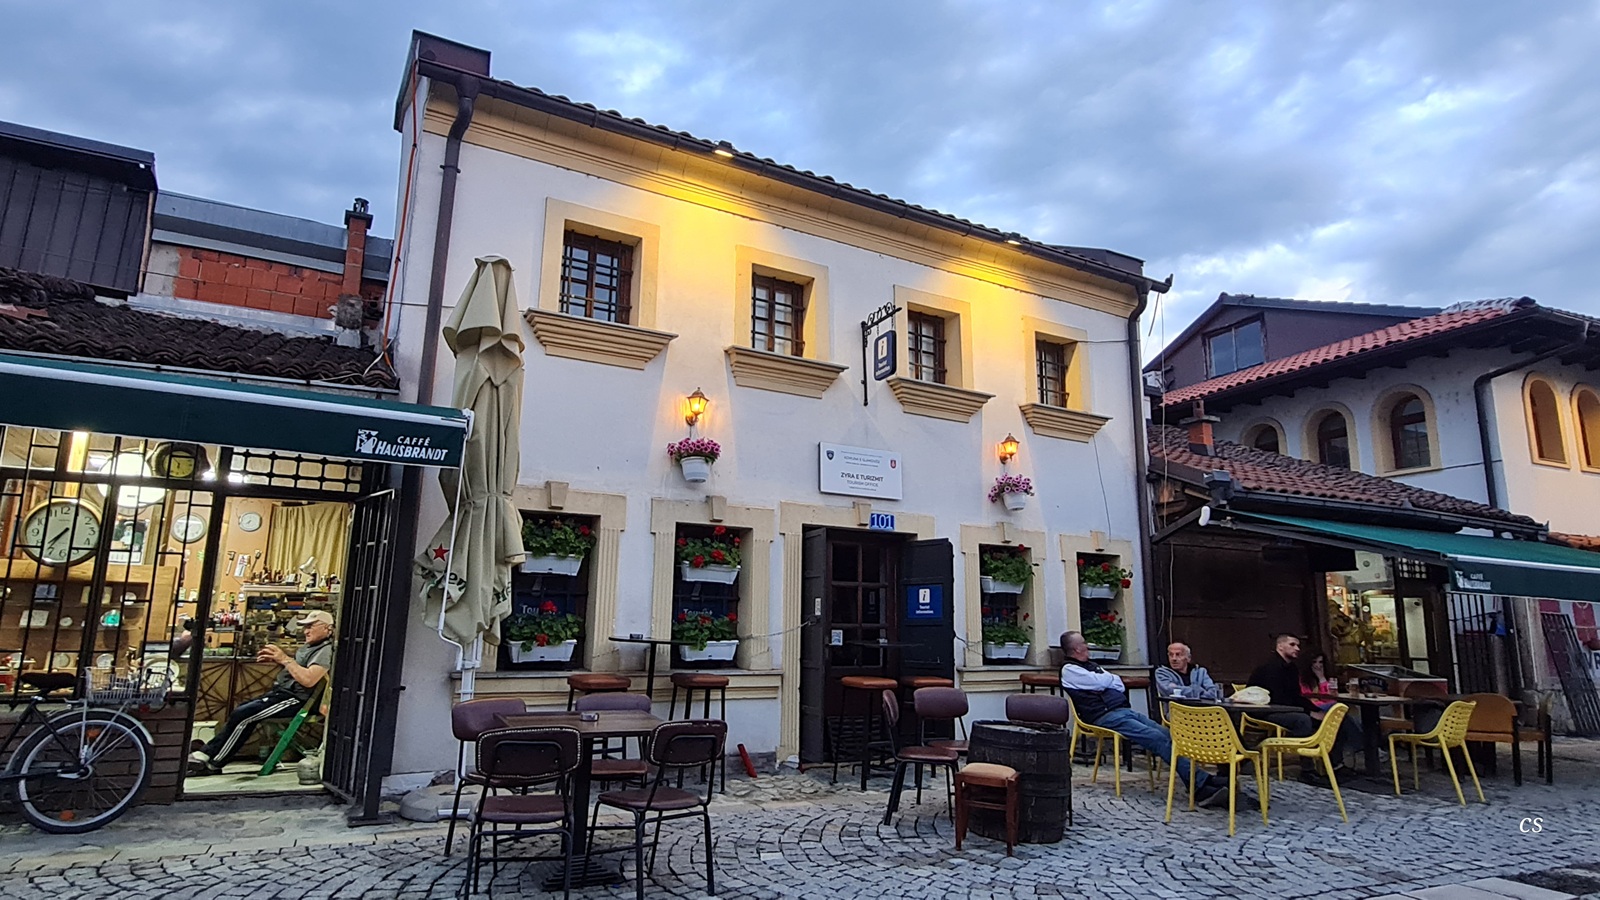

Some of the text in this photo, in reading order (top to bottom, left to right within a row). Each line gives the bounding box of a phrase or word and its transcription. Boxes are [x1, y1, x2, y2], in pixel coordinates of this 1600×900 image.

[374, 440, 449, 461] HAUSBRANDT
[860, 474, 884, 482] TURIZMIT
[60, 505, 71, 515] 12
[84, 516, 92, 525] 2
[871, 513, 894, 529] 101
[31, 527, 40, 537] 9
[88, 526, 96, 536] 3
[58, 548, 67, 558] 6
